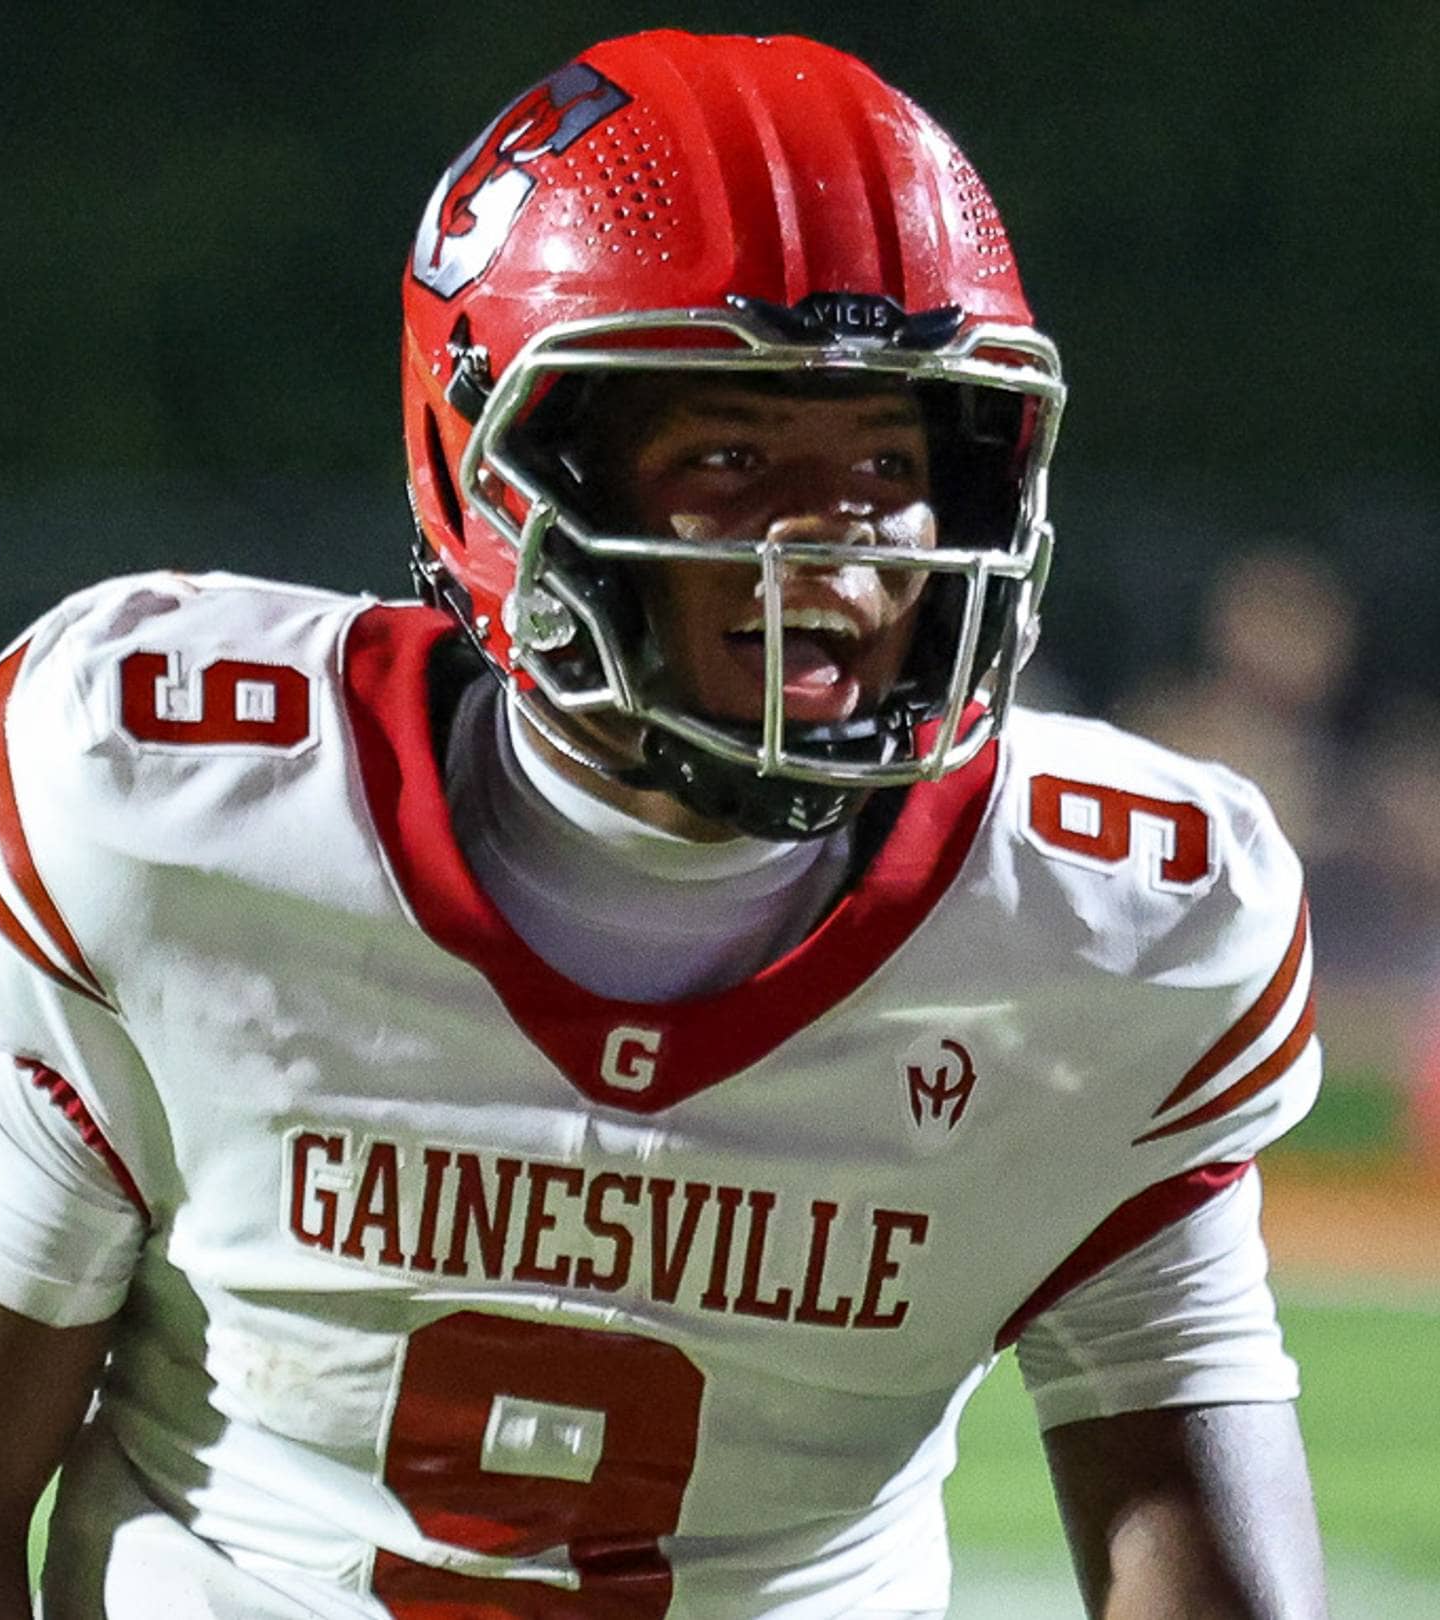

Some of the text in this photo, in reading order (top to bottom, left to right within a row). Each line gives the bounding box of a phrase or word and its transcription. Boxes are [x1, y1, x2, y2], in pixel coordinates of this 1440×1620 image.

[814, 304, 889, 328] VICIS
[120, 650, 310, 748] 9
[1029, 773, 1210, 885] 9
[601, 1025, 662, 1093] G
[288, 1132, 930, 1330] GAINESVILLE
[368, 1310, 706, 1620] 9
